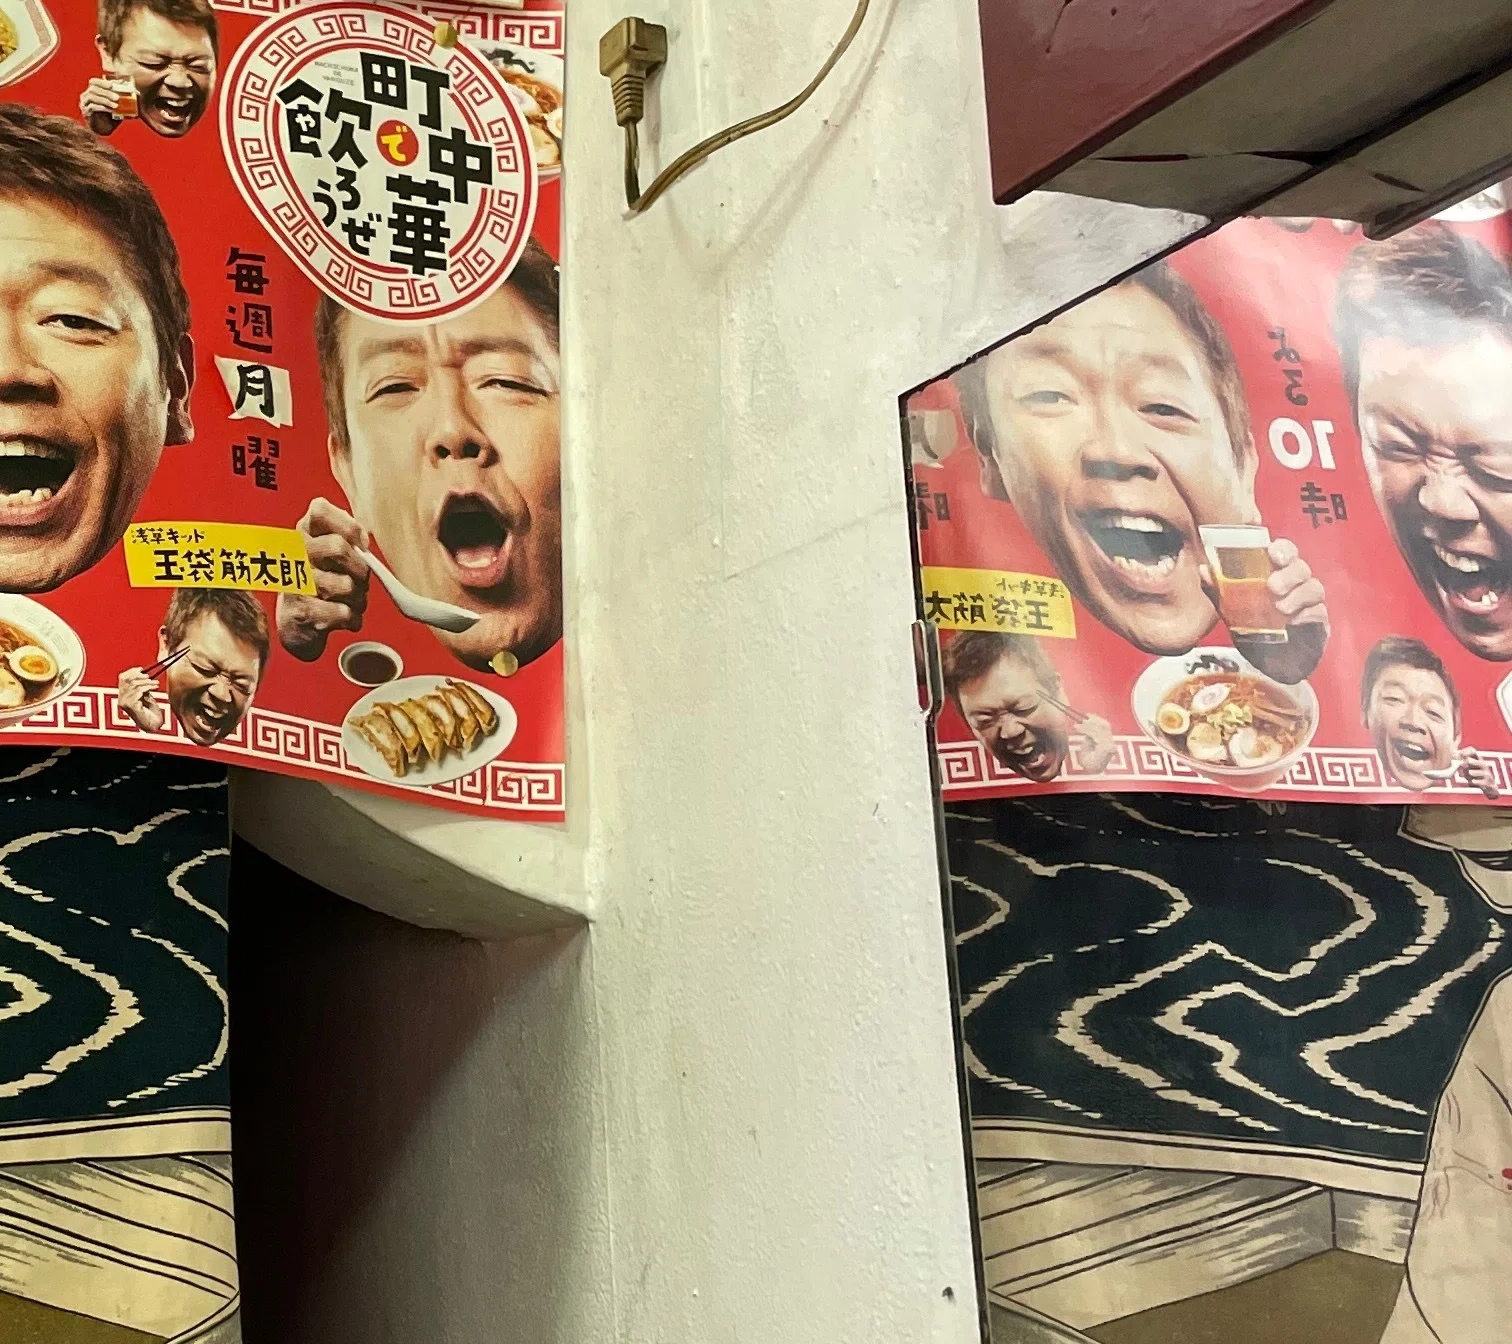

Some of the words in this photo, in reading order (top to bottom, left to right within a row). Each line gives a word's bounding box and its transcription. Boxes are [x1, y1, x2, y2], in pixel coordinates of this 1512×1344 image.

[224, 246, 281, 493] 毎週月曜
[154, 547, 309, 590] 玉袋筋太郎
